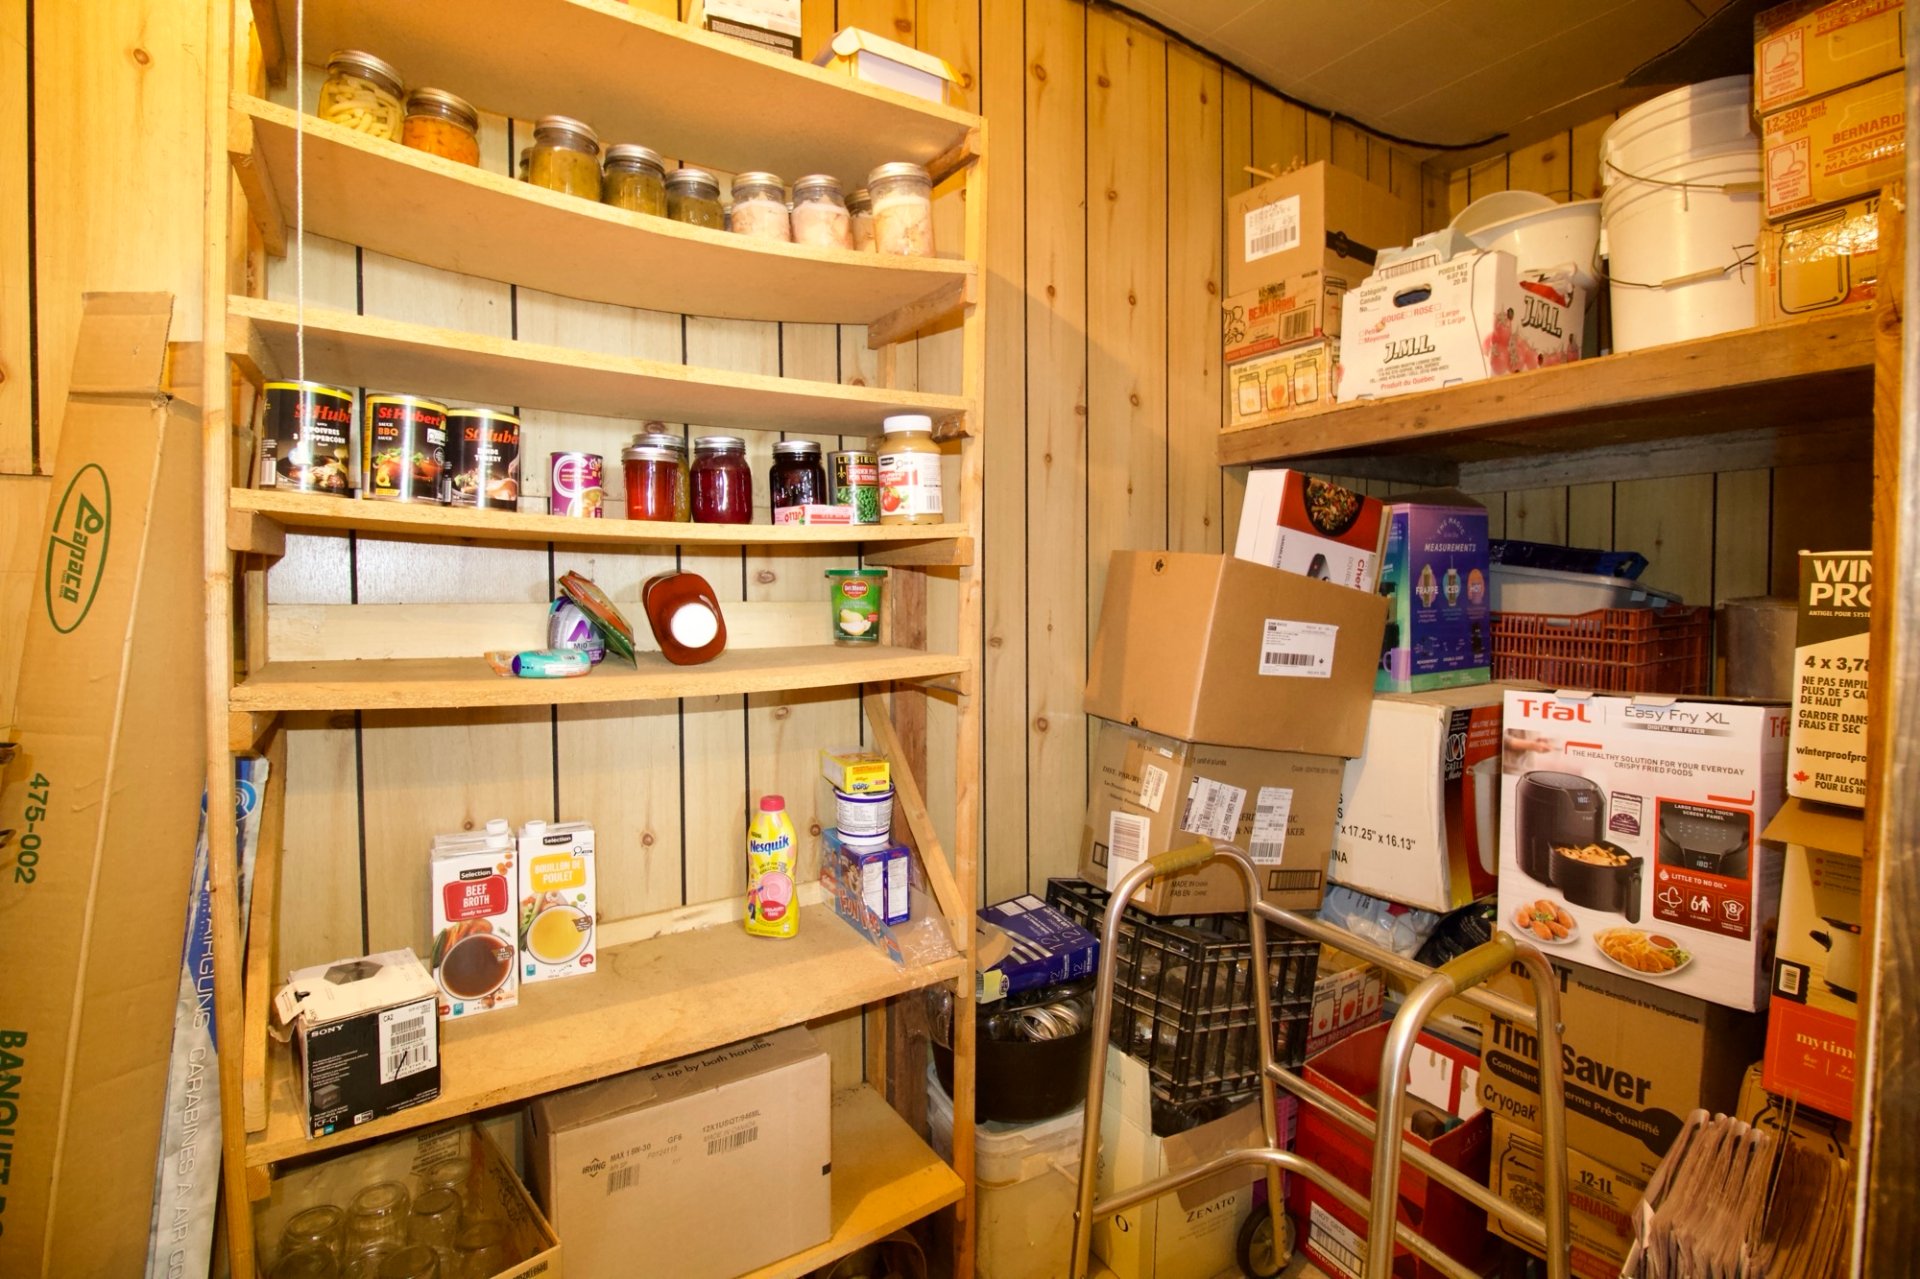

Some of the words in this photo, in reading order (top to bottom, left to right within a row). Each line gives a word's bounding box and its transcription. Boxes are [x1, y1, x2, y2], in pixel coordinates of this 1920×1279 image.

[1832, 112, 1905, 144] BERNARDI
[378, 427, 399, 437] BBQ
[1424, 543, 1477, 553] MEASUREMENTS
[1813, 559, 1873, 583] WIN
[1810, 582, 1872, 608] PRO
[1804, 655, 1816, 669] 4
[1821, 659, 1831, 670] x
[1836, 657, 1870, 674] 3,78
[1802, 675, 1815, 685] NE
[1817, 676, 1836, 687] PAS
[1838, 678, 1869, 690] EMPIL
[1801, 686, 1826, 697] PLUS
[1828, 687, 1841, 698] DE
[1843, 688, 1850, 698] 5
[1800, 695, 1813, 705] DE
[1815, 697, 1842, 708] HAUT
[1517, 699, 1592, 723] T-fal
[1624, 706, 1665, 723] Easy
[1669, 708, 1700, 726] Fry
[1704, 710, 1730, 726] XL
[1799, 709, 1839, 722] GARDER
[1841, 712, 1869, 725] DANS
[1647, 724, 1671, 733] DIGITAL
[1672, 726, 1684, 734] AIR
[1684, 727, 1705, 736] FRYER
[1770, 717, 1791, 739] T-fa
[1798, 719, 1827, 732] FRAIS
[1829, 722, 1839, 732] ET
[1842, 723, 1861, 735] SEC
[1572, 750, 1586, 758] THE
[1587, 751, 1619, 762] HEALTHY
[1621, 755, 1658, 766] SOLUTION
[1660, 759, 1676, 768] FOR
[1678, 761, 1699, 770] YOUR
[1701, 764, 1745, 776] EVERYDAY
[1796, 746, 1868, 764] winterproofpro
[1614, 762, 1640, 771] CRISPY
[1642, 764, 1665, 774] FRIED
[1666, 767, 1693, 777] FOODS
[1814, 780, 1838, 792] POUR
[1840, 783, 1854, 794] LES
[1815, 772, 1832, 783] FAIT
[1835, 774, 1847, 784] AU
[1848, 775, 1866, 787] CAN
[15, 773, 50, 884] 475-002
[1341, 825, 1346, 835] x
[1378, 834, 1384, 844] x
[544, 836, 572, 845] Selection
[750, 835, 790, 856] Nesquik
[1332, 849, 1348, 864] INA
[461, 870, 491, 880] Selection
[543, 871, 573, 884] POULET
[1671, 873, 1693, 883] LITTLE
[1694, 877, 1702, 885] TO
[1703, 879, 1713, 887] NO
[466, 884, 487, 898] BEEF
[463, 895, 490, 909] BROTH
[1690, 895, 1698, 911] 6
[1729, 903, 1737, 913] 8
[311, 1024, 344, 1038] SONY
[1796, 1032, 1857, 1060] mytim
[667, 1067, 683, 1077] up
[684, 1063, 700, 1073] by
[701, 1054, 728, 1068] both
[1490, 1013, 1538, 1061] Tim
[1562, 1043, 1652, 1106] Saver
[178, 1046, 207, 1176] CARABINES
[1483, 1084, 1537, 1122] Cryopak
[314, 1115, 338, 1128] ICF-C1
[610, 1151, 625, 1162] MAX
[582, 1160, 606, 1175] IRVING
[1186, 1195, 1236, 1224] ZENATO
[170, 1207, 191, 1249] AIR
[167, 1250, 186, 1279] CO
